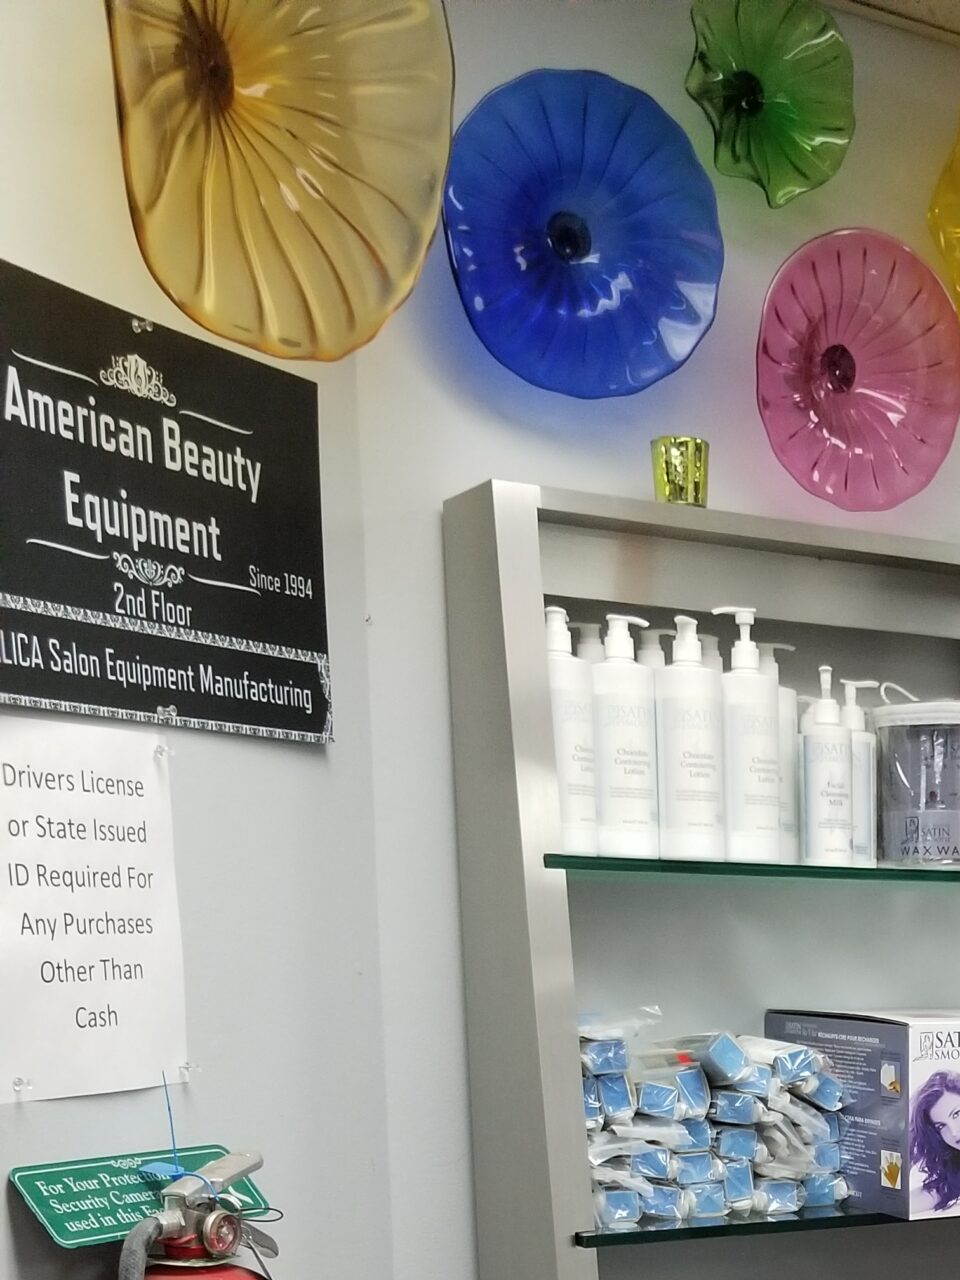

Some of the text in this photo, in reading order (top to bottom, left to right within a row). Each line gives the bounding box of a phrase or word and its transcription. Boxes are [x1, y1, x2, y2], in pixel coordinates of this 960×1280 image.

[4, 365, 261, 503] American Beauty
[64, 470, 222, 561] Equipment
[249, 565, 312, 600] Since 1994
[113, 582, 192, 627] 2nd Floor
[0, 629, 312, 714] LICA Salon Equipment Manufacturing
[2, 763, 144, 797] Drivers License
[8, 815, 147, 843] or State Issued
[900, 846, 932, 856] WAX
[8, 863, 154, 893] ID Required For
[21, 911, 153, 941] Any Purchases
[40, 957, 143, 983] Other Than
[75, 1003, 118, 1029] Cash
[35, 1179, 65, 1197] For
[65, 1174, 101, 1193] Your
[50, 1189, 163, 1215] Security Camera
[64, 1216, 98, 1233] used
[100, 1213, 115, 1227] in
[117, 1208, 143, 1225] this
